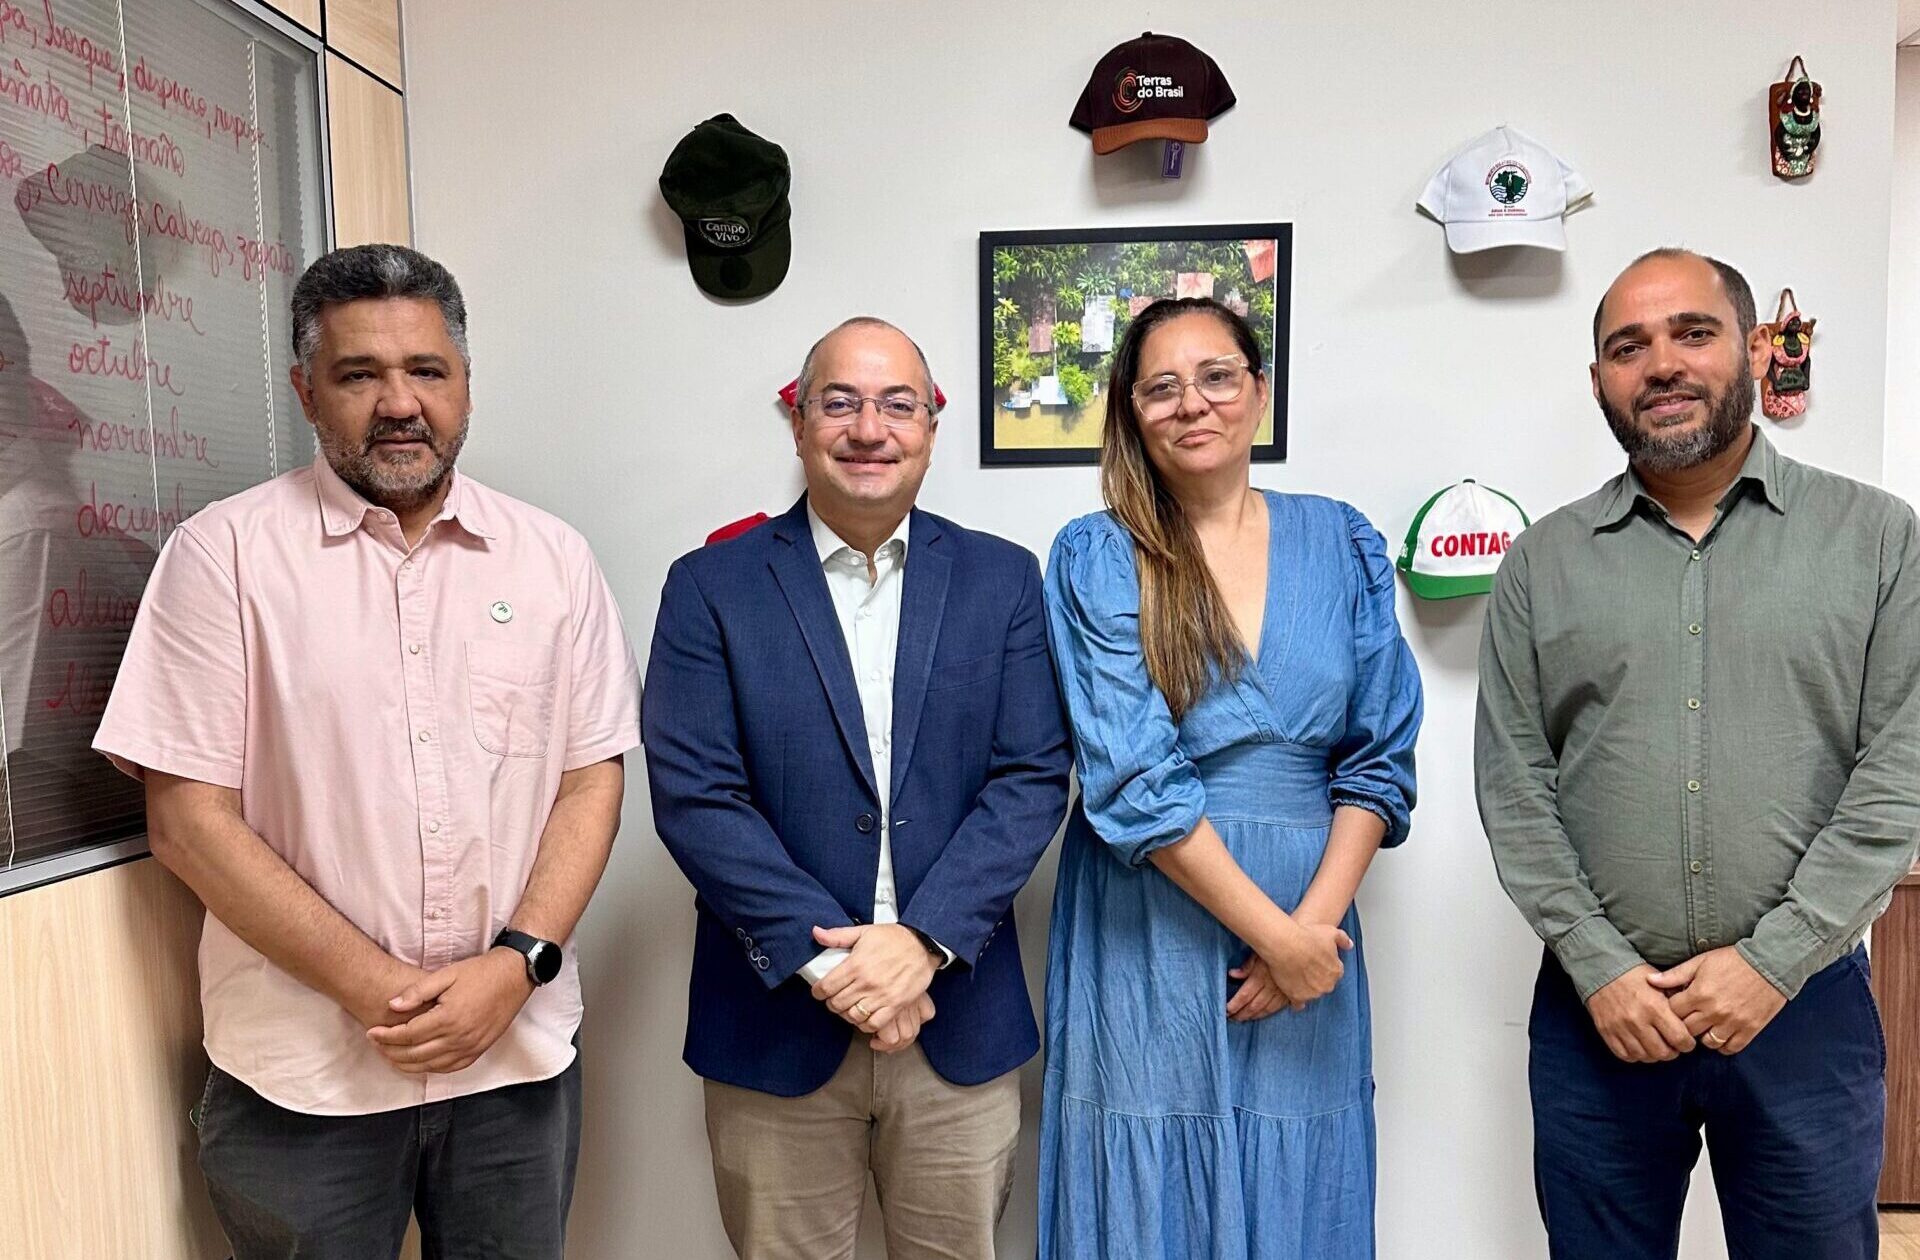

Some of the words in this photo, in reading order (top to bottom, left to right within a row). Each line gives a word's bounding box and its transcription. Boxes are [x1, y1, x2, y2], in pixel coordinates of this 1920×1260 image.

[1136, 75, 1172, 87] Terras
[1137, 86, 1153, 98] do
[1155, 86, 1184, 98] Brasil
[63, 262, 206, 336] septiembre
[69, 335, 184, 396] octubre
[68, 405, 220, 469] noviembre
[1430, 531, 1512, 558] CONTAG
